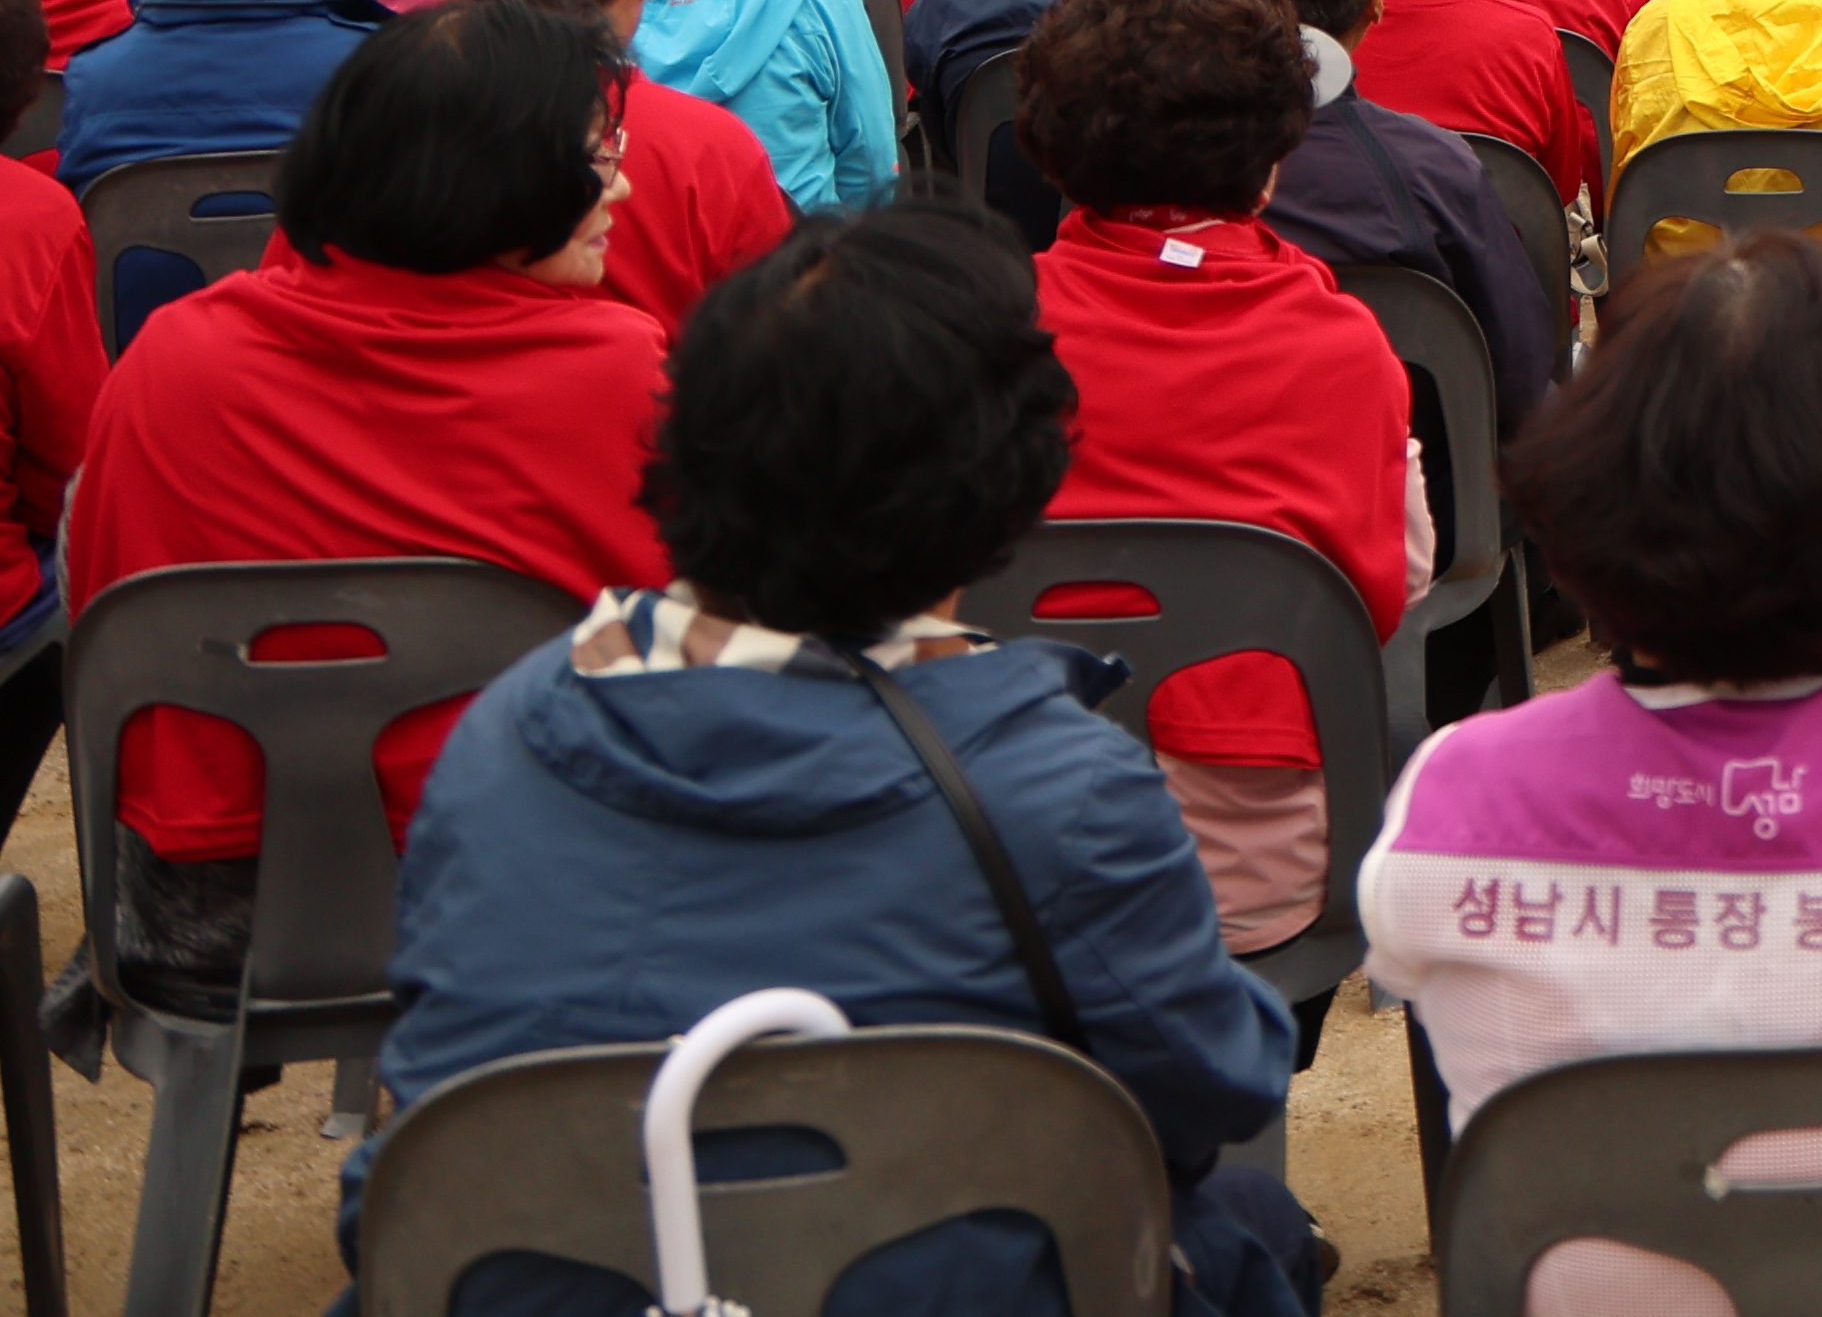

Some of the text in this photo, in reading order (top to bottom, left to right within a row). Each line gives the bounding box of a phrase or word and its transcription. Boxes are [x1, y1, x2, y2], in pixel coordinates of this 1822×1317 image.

[1627, 773, 1715, 809] 희망도시
[1453, 877, 1621, 946] 성남시
[1649, 888, 1767, 950] 통장
